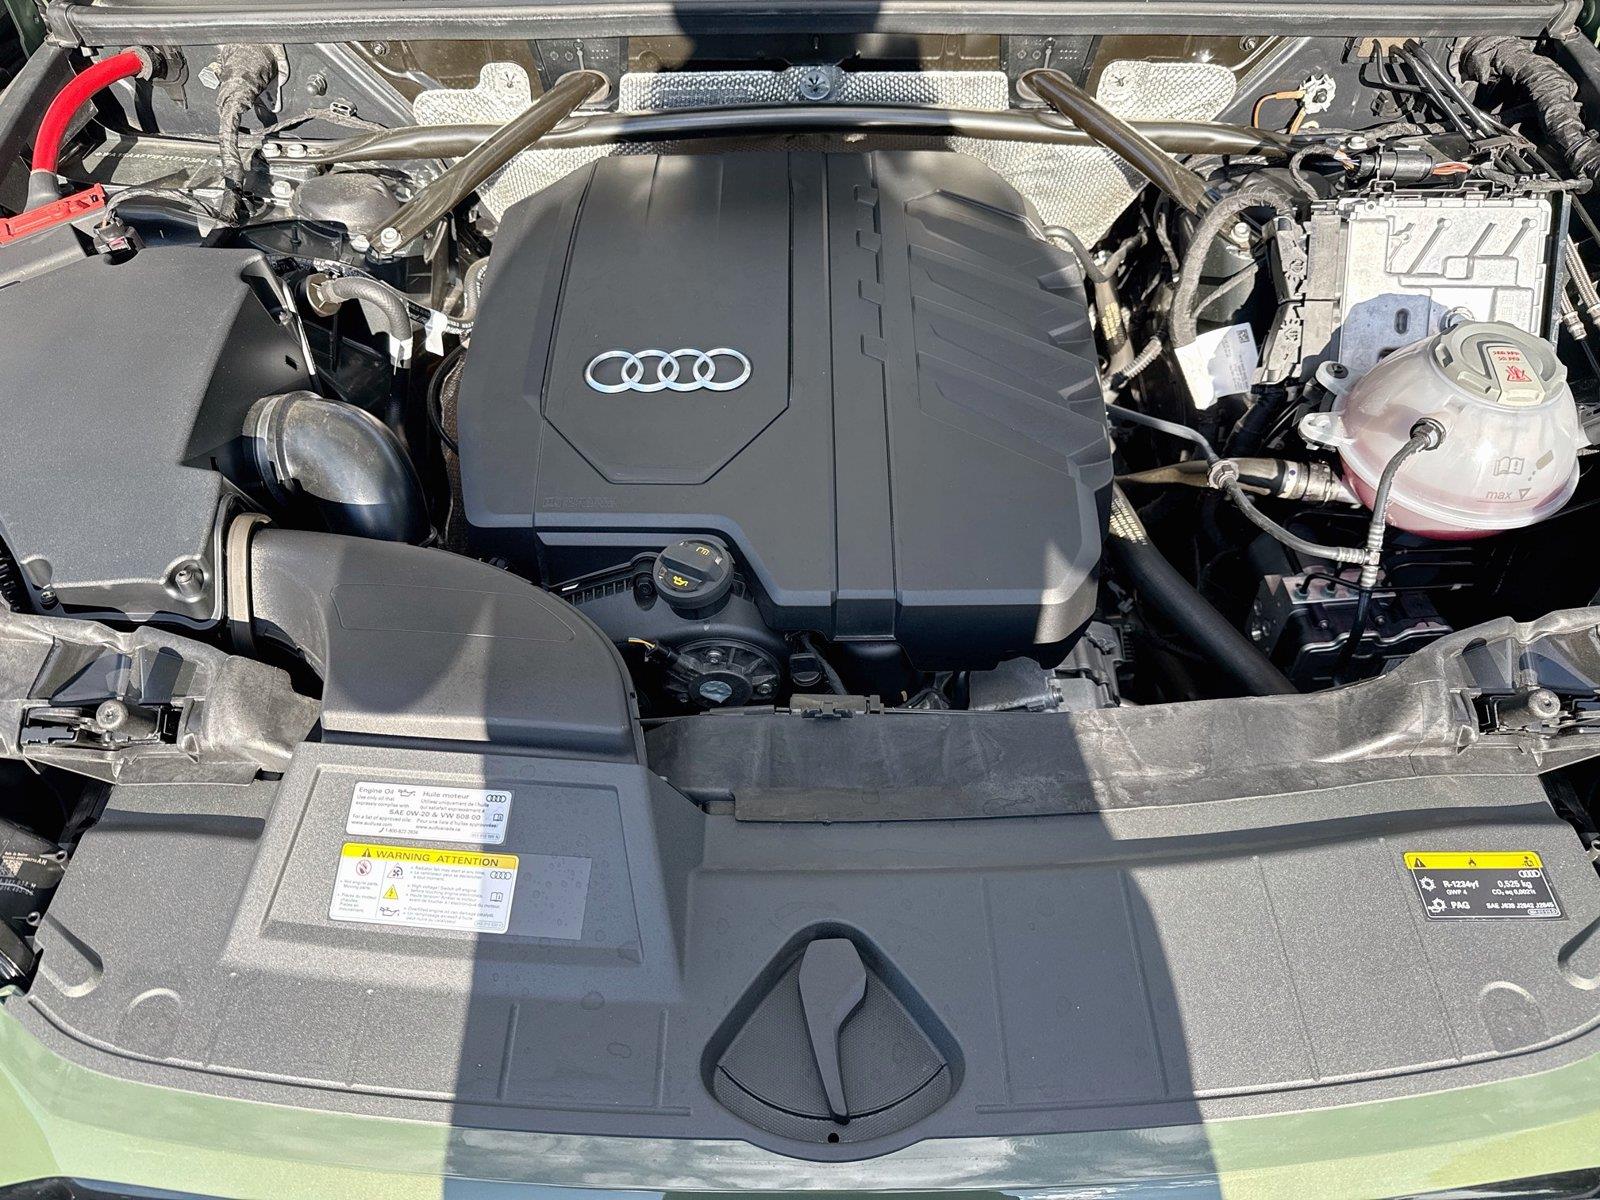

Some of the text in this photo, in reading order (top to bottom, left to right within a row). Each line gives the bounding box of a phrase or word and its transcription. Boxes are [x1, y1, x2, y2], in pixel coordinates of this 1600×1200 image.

[1486, 491, 1512, 500] max
[359, 787, 382, 795] Engine
[376, 850, 499, 867] WARNING ATTENTION
[1442, 879, 1533, 889] R-1234yf 0,525 kg
[1450, 900, 1471, 909] PAG
